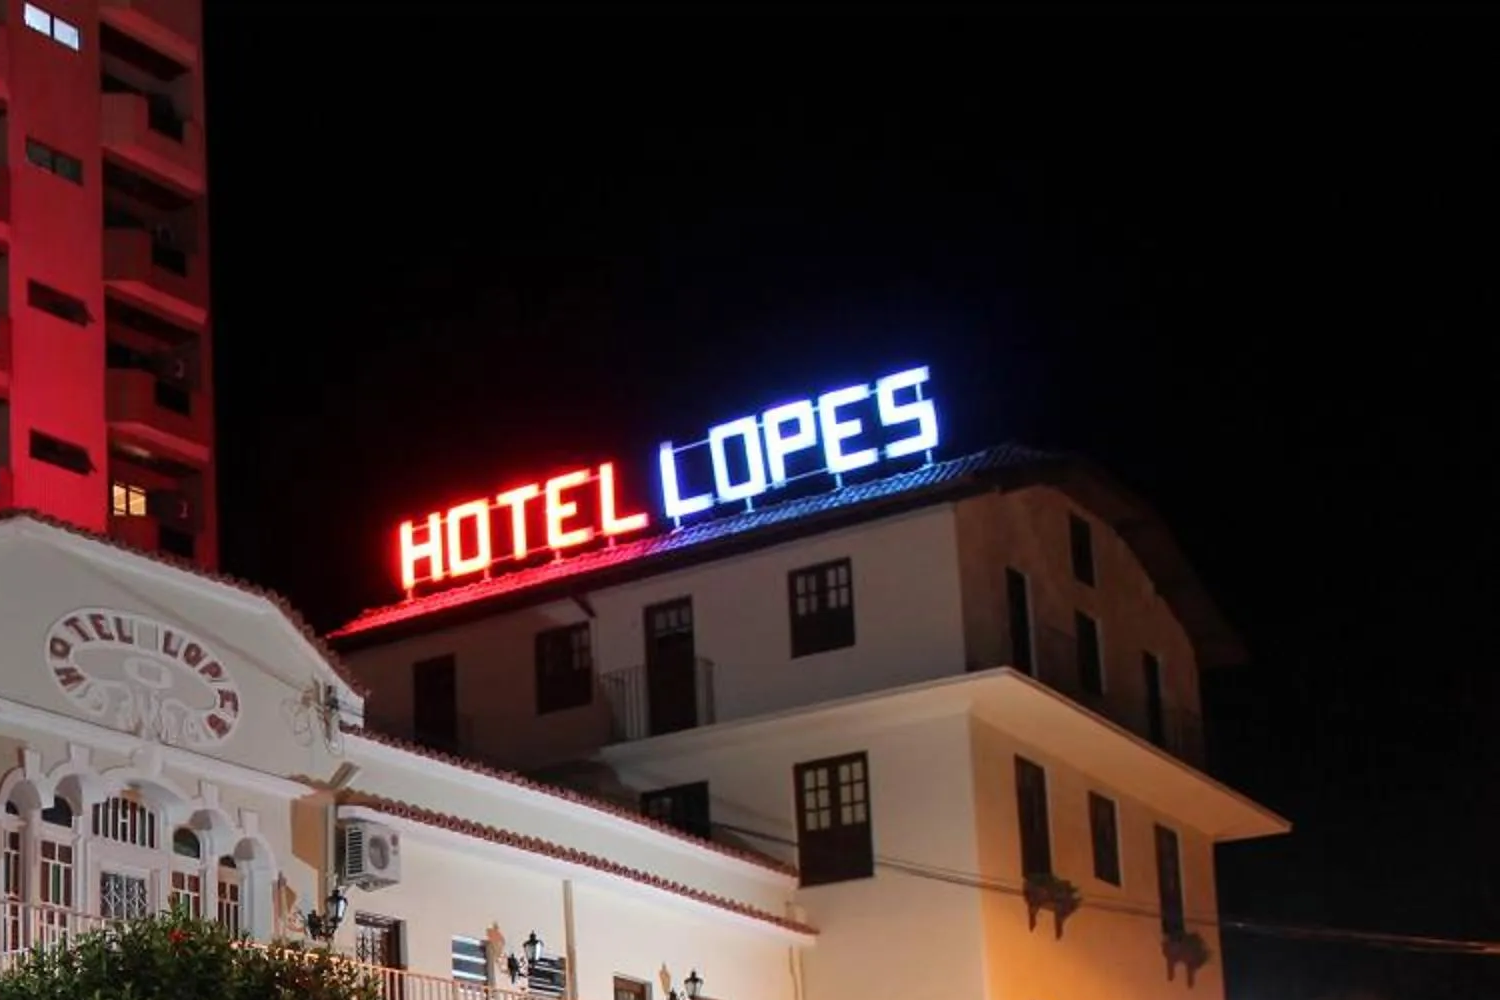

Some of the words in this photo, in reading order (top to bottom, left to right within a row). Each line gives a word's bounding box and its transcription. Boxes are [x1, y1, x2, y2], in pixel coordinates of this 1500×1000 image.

[399, 462, 649, 590] HOTEL
[659, 365, 938, 519] LOPES
[50, 613, 134, 693] HOTEL
[162, 630, 239, 740] LOPES
